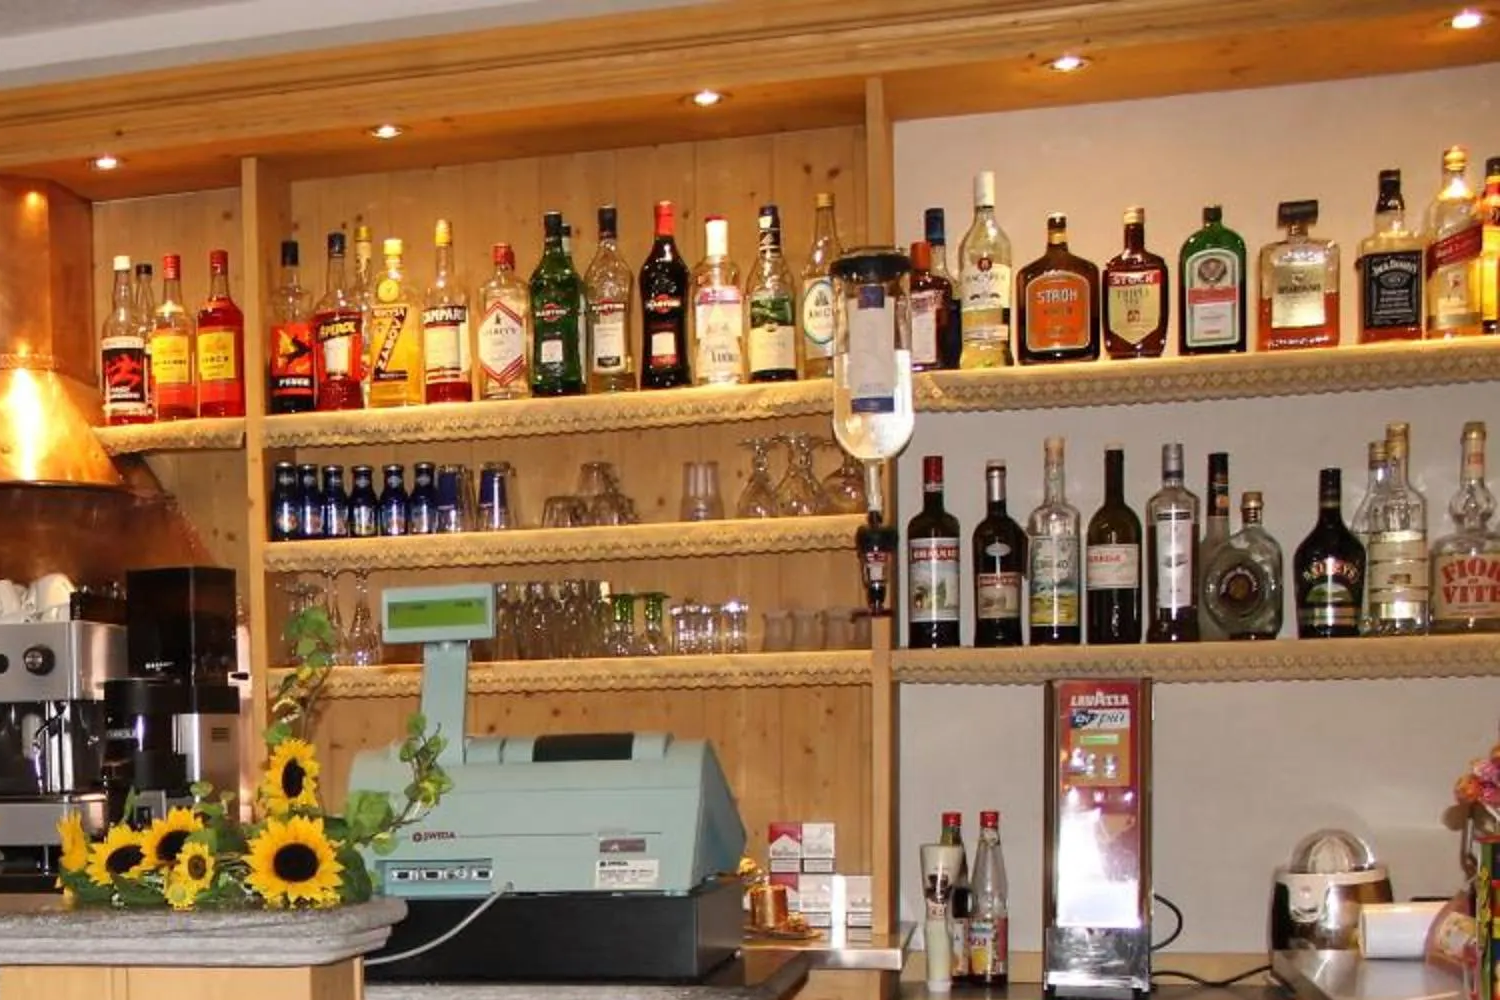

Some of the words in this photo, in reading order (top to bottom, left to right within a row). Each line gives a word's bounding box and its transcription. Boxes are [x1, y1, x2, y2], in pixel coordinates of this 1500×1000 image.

[1037, 289, 1078, 303] STROH
[378, 308, 406, 371] ZABOV
[1070, 688, 1129, 707] LAVAZZA
